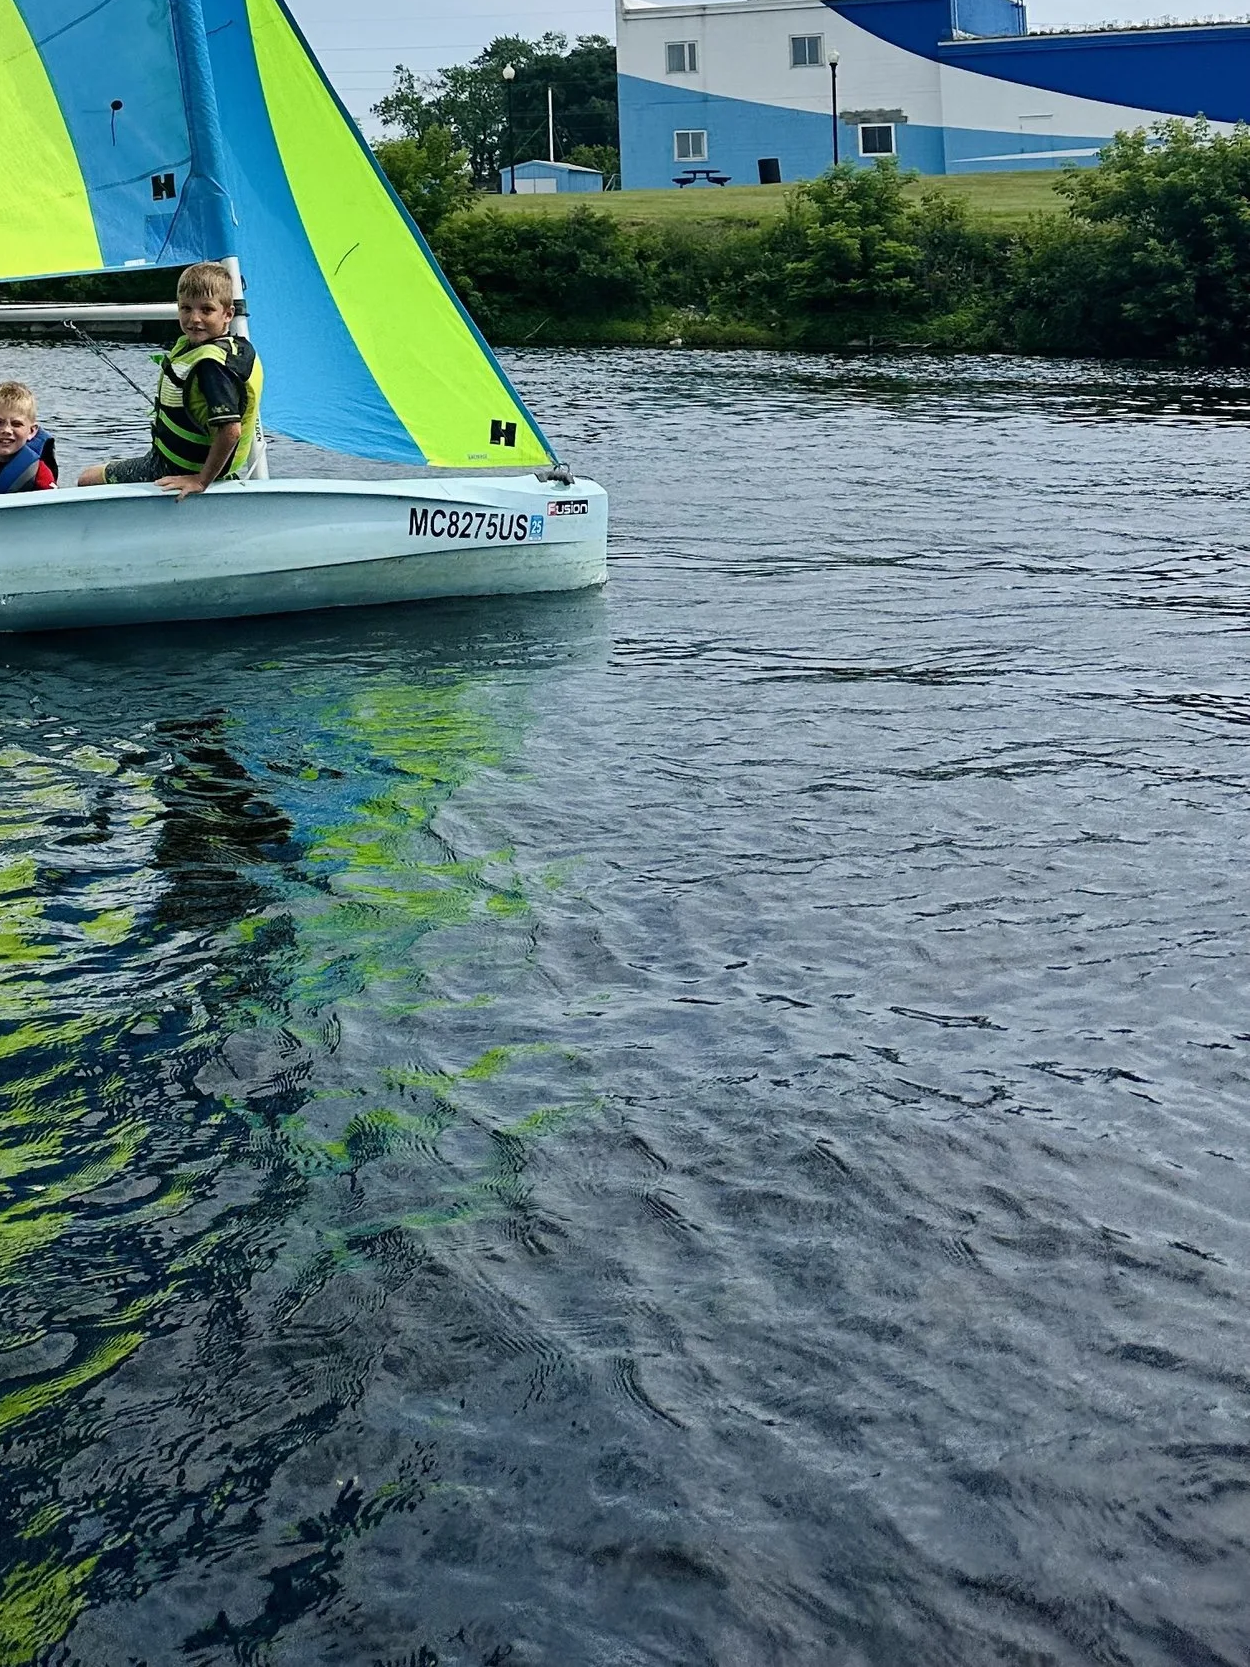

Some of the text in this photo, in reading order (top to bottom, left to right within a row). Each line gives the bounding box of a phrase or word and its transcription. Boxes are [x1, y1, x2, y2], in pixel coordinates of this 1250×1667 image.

[547, 501, 588, 516] Fusion
[409, 507, 528, 541] MC8275US
[531, 520, 542, 534] 25
